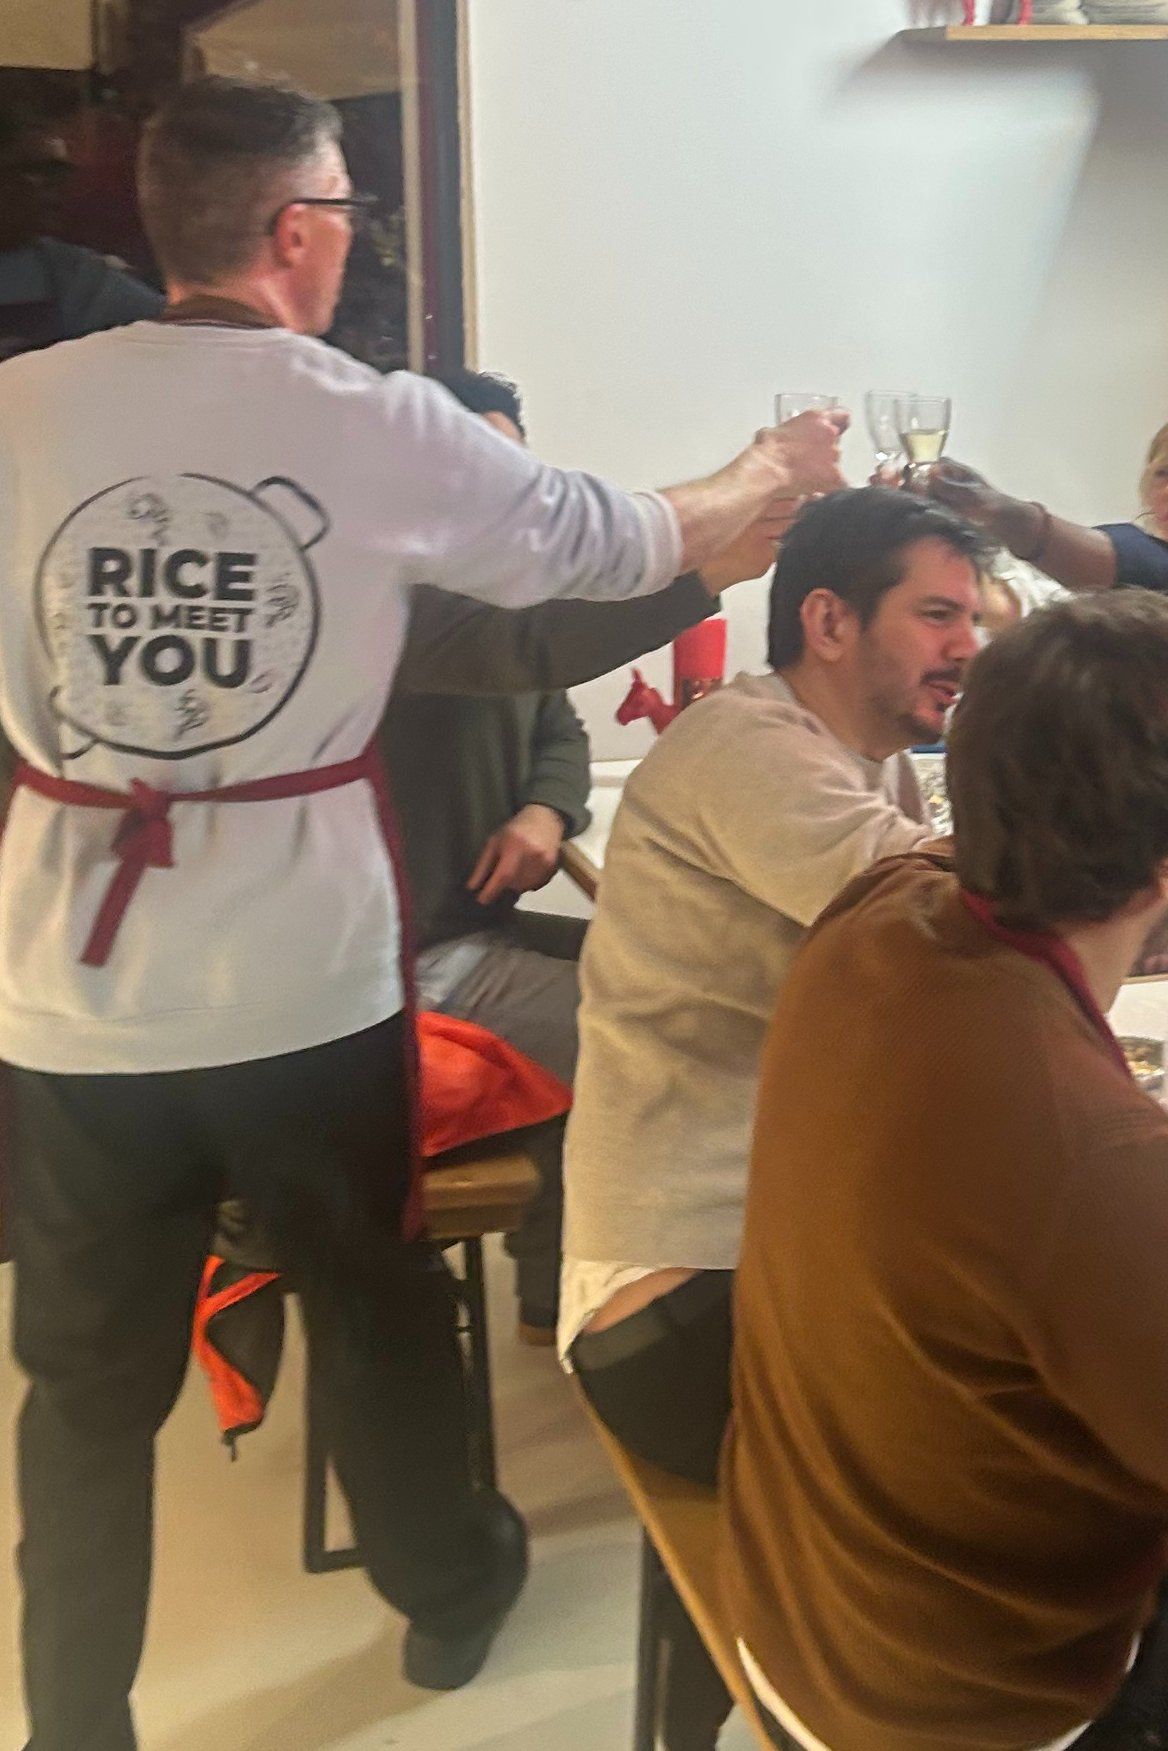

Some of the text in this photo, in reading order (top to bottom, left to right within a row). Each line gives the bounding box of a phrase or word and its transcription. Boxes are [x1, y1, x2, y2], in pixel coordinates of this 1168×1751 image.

[88, 547, 257, 601] RICE
[87, 602, 254, 632] TO MEET
[88, 634, 252, 689] YOU
